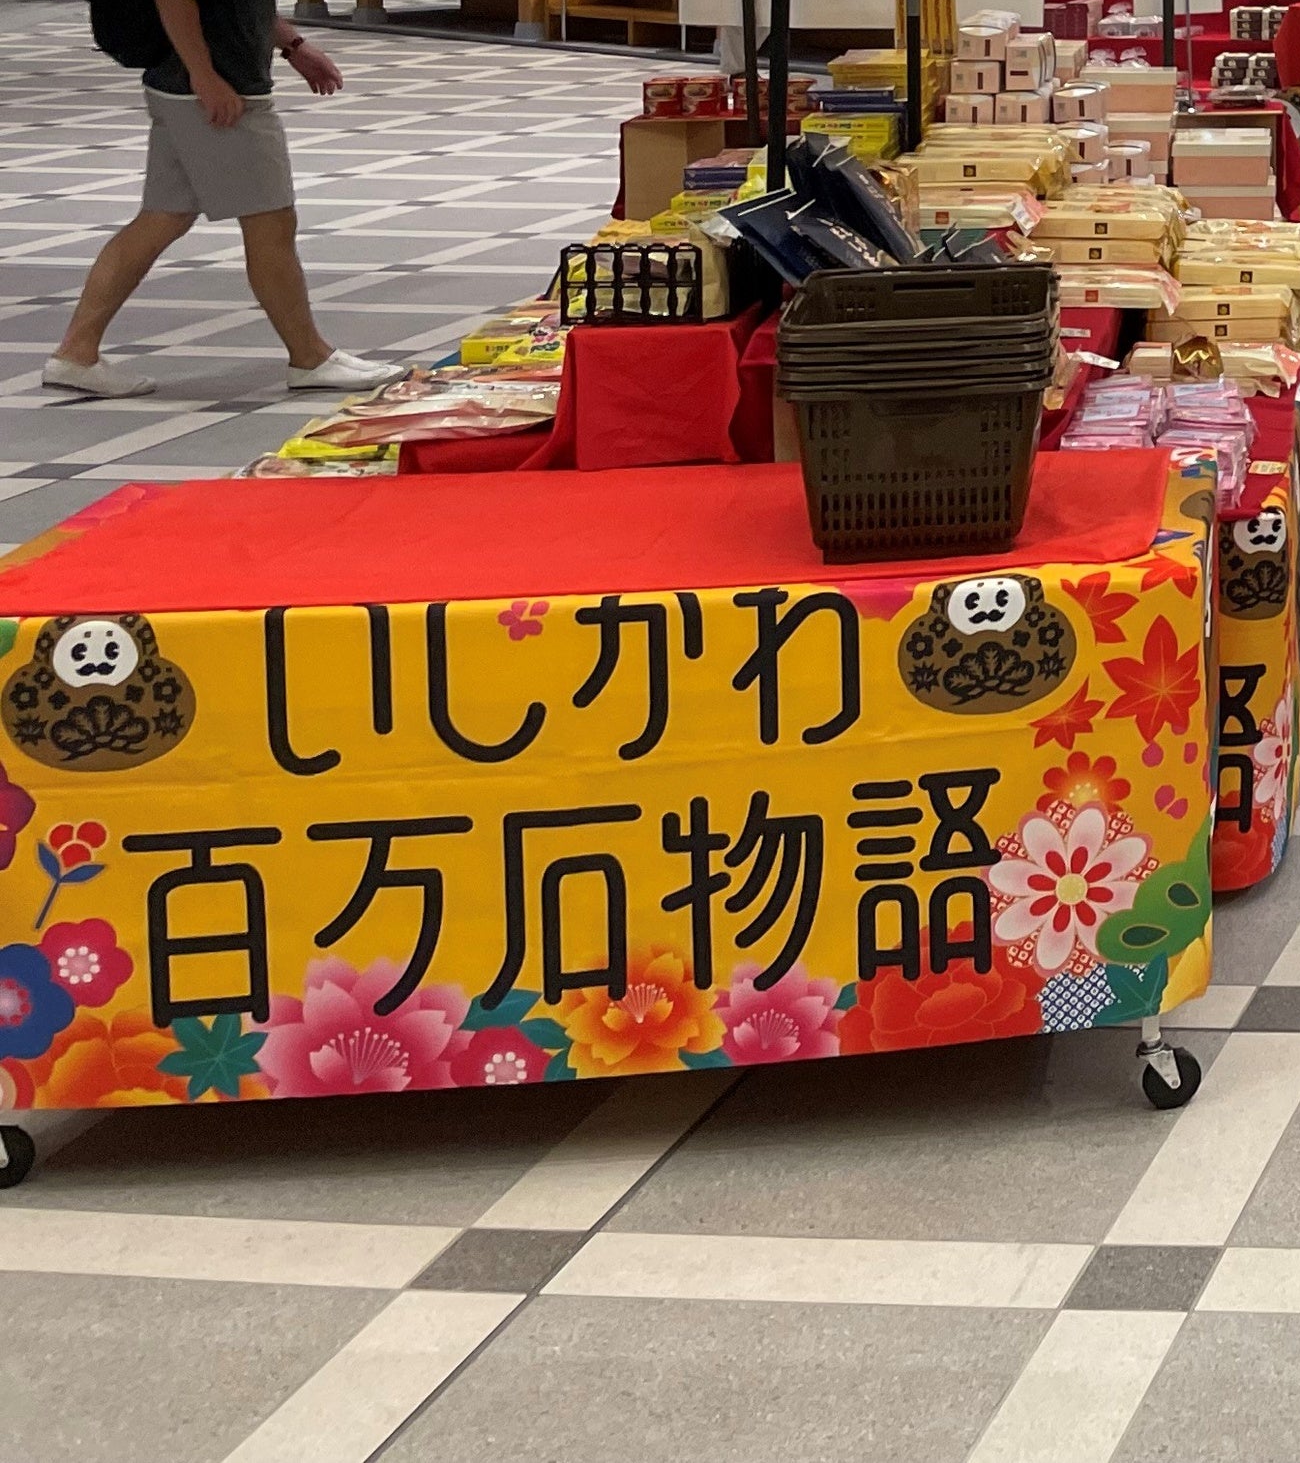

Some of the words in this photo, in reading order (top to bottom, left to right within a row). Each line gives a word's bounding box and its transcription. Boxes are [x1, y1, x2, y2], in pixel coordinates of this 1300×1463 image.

[266, 586, 862, 775] いしかわ
[122, 767, 1002, 1025] 百万石物語
